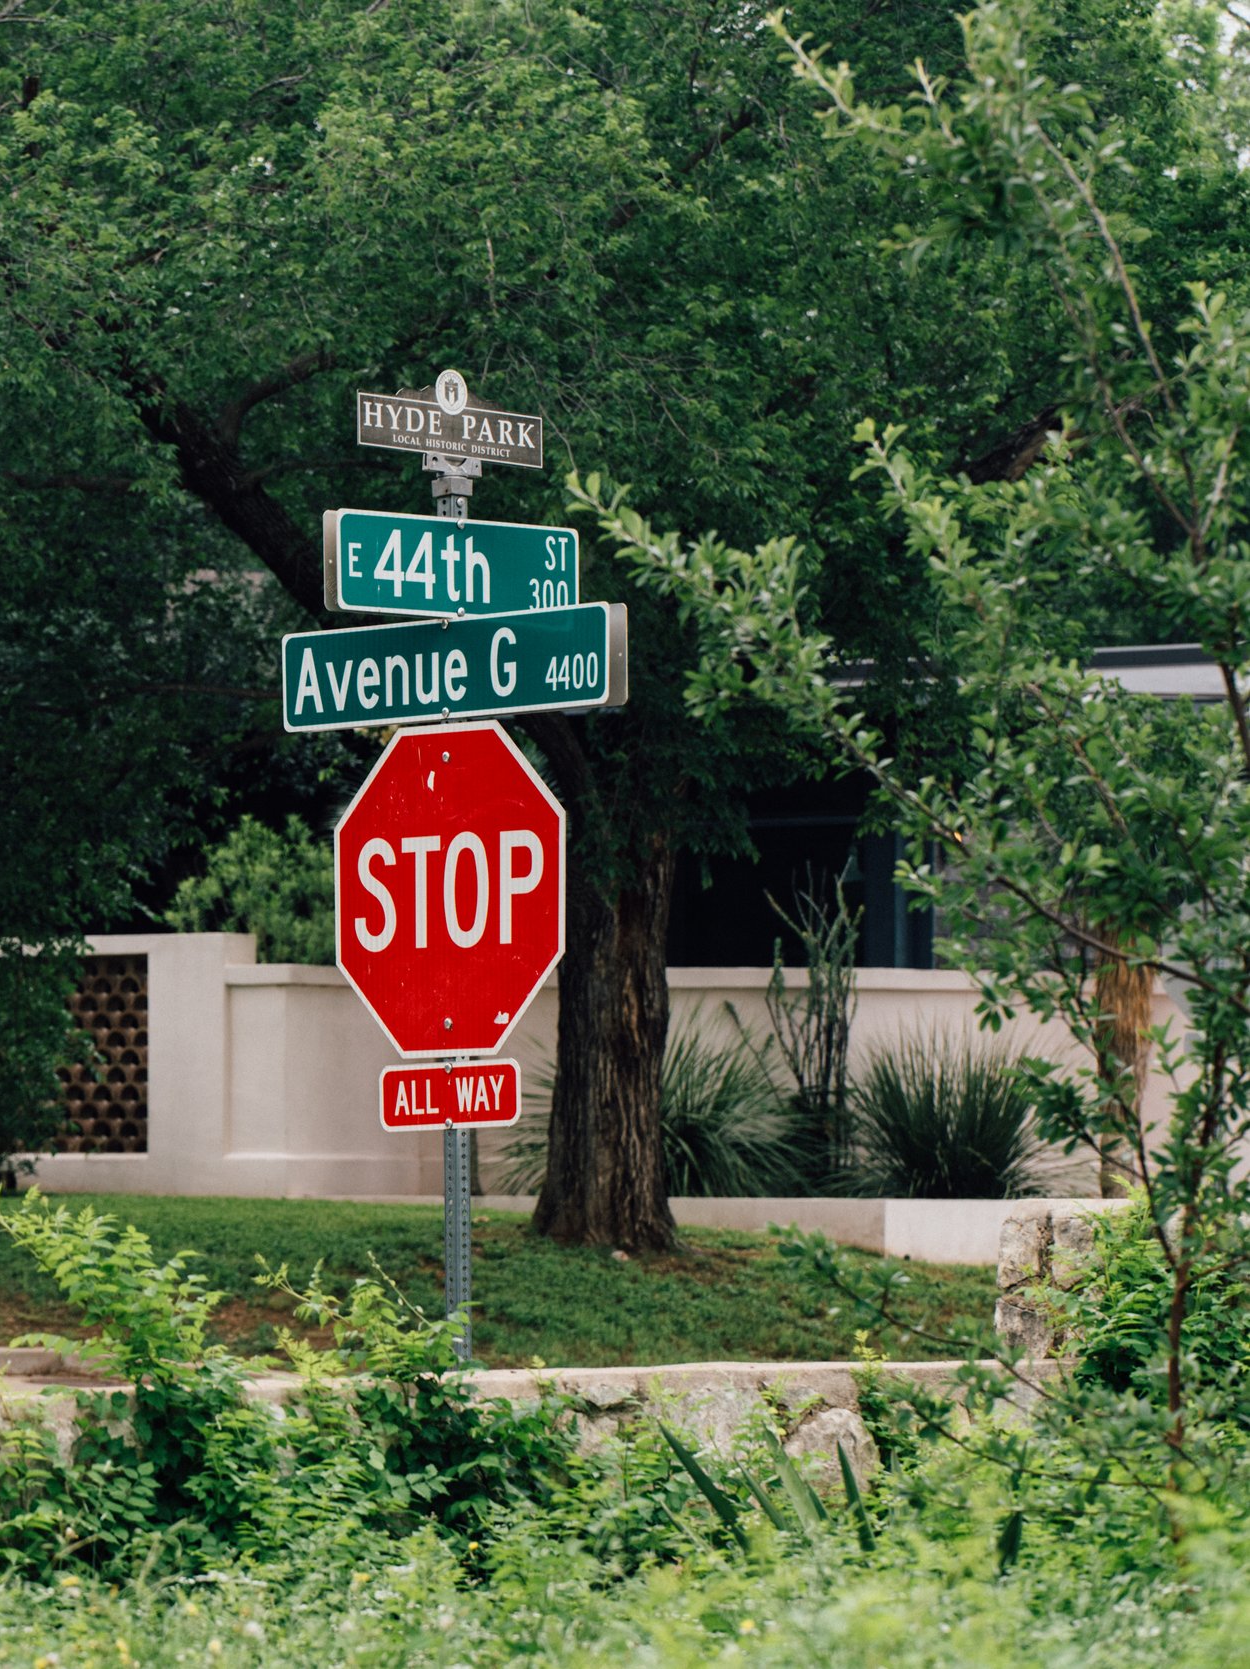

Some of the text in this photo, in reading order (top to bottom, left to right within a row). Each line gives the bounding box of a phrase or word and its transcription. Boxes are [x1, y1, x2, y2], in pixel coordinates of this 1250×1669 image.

[363, 401, 535, 449] HYDE PARK
[392, 434, 510, 458] LOCAL HISTORIC DISTRICT
[348, 529, 568, 604] E 44th ST
[529, 578, 569, 610] 300
[294, 627, 599, 715] Avenue G 4400
[354, 829, 544, 953] STOP
[394, 1075, 505, 1116] ALL WAY
